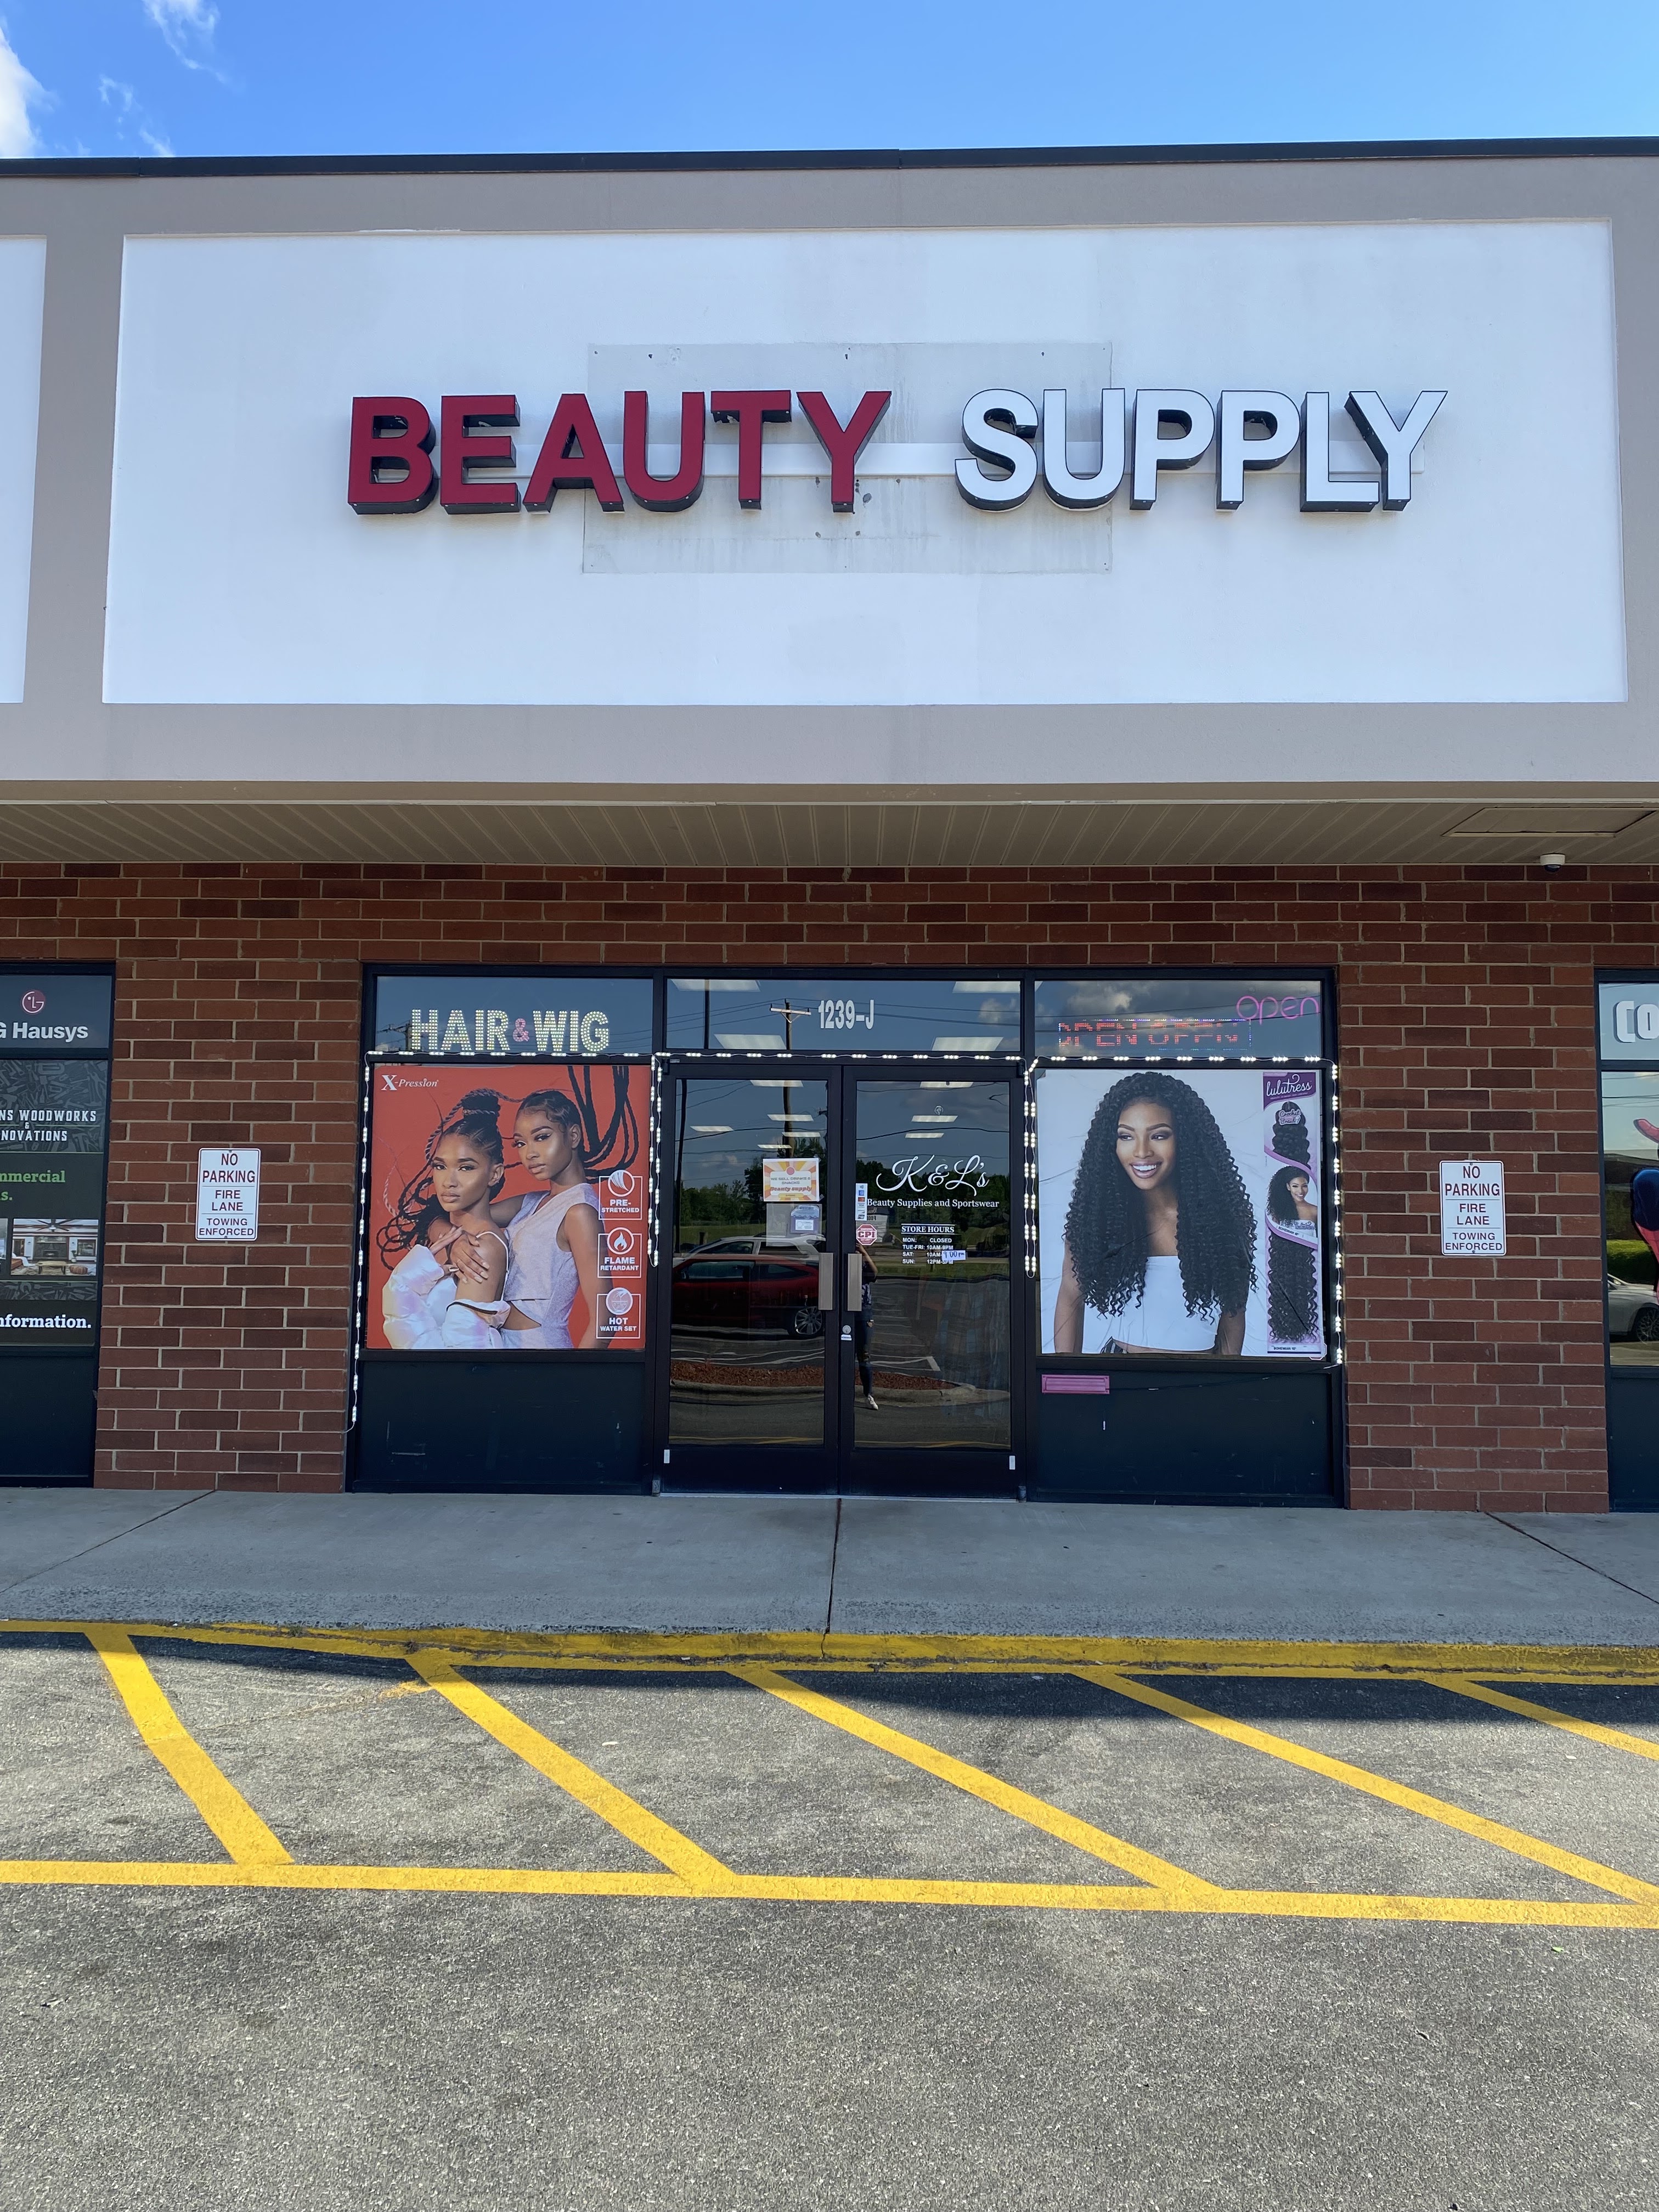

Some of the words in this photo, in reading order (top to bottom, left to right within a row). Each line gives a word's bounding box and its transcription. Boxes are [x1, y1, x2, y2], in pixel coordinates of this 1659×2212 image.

[347, 390, 892, 515] BEAUTY
[955, 388, 1448, 512] SUPPLY
[818, 999, 874, 1029] 1239-J
[12, 1022, 88, 1043] Hausys
[411, 1008, 510, 1051] HAIR
[533, 1010, 610, 1052] WIG
[1266, 1074, 1312, 1096] lulutress
[19, 1109, 97, 1121] WOODWORKS
[1, 1130, 67, 1141] NOVATIONS
[221, 1153, 238, 1165] NO
[202, 1170, 255, 1183] PARKING
[1463, 1166, 1480, 1178] NO
[215, 1190, 240, 1199] FIRE
[1445, 1183, 1500, 1196] PARKING
[212, 1202, 243, 1211] LANE
[867, 1198, 895, 1208] Beauty
[897, 1198, 932, 1208] Supplies
[934, 1199, 950, 1207] and
[952, 1199, 1000, 1209] Sportswear
[1459, 1203, 1486, 1212] FIRE
[1457, 1216, 1489, 1225] LANE
